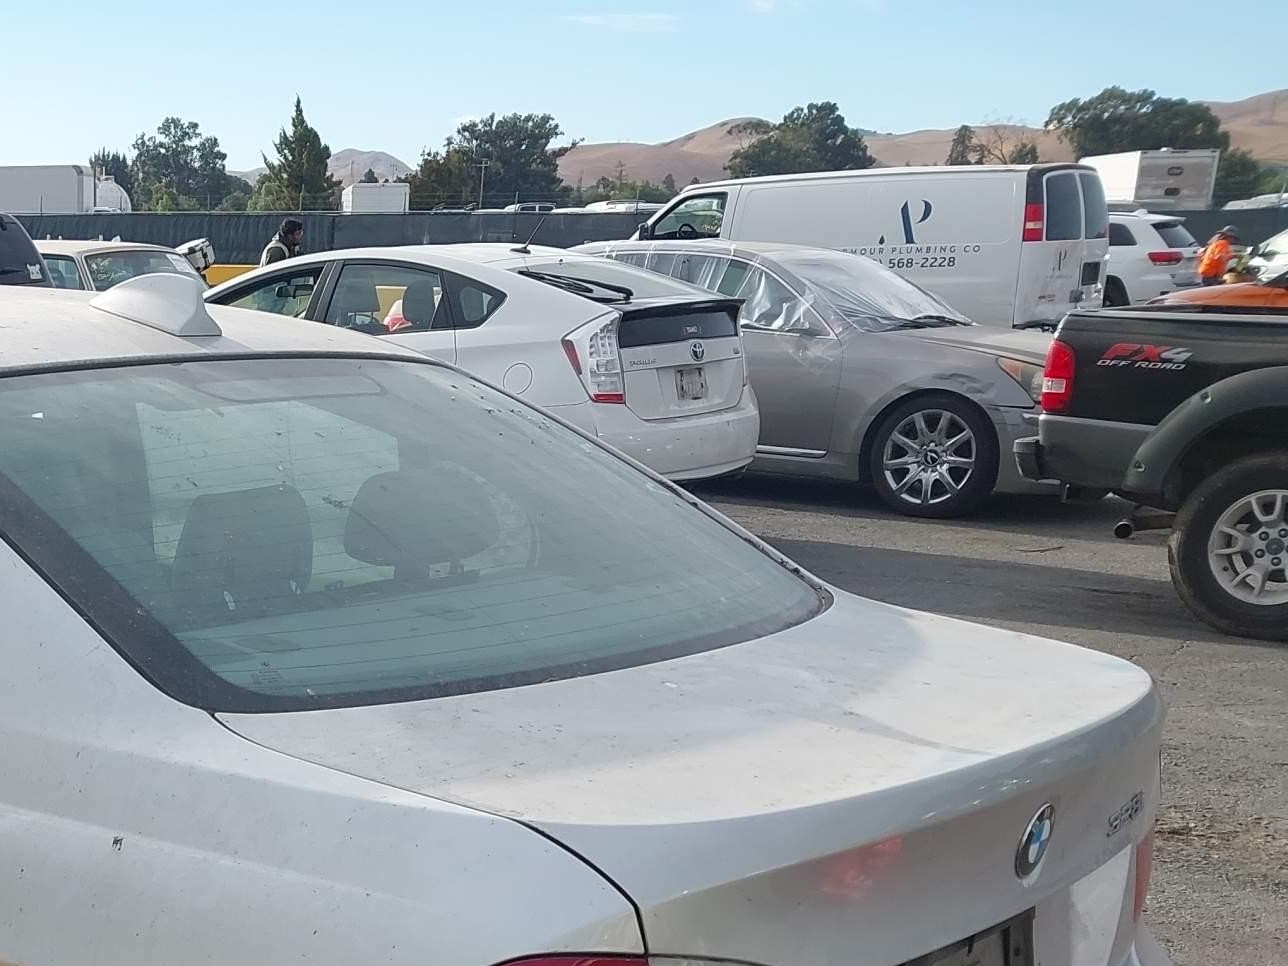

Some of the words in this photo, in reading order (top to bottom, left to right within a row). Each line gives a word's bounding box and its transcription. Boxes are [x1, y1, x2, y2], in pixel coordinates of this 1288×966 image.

[892, 246, 956, 254] PLUMBING
[963, 245, 981, 253] CO
[888, 256, 956, 269] 568-2228
[1102, 343, 1192, 363] FX4
[1097, 359, 1132, 367] OFF
[1134, 361, 1187, 370] ROAD
